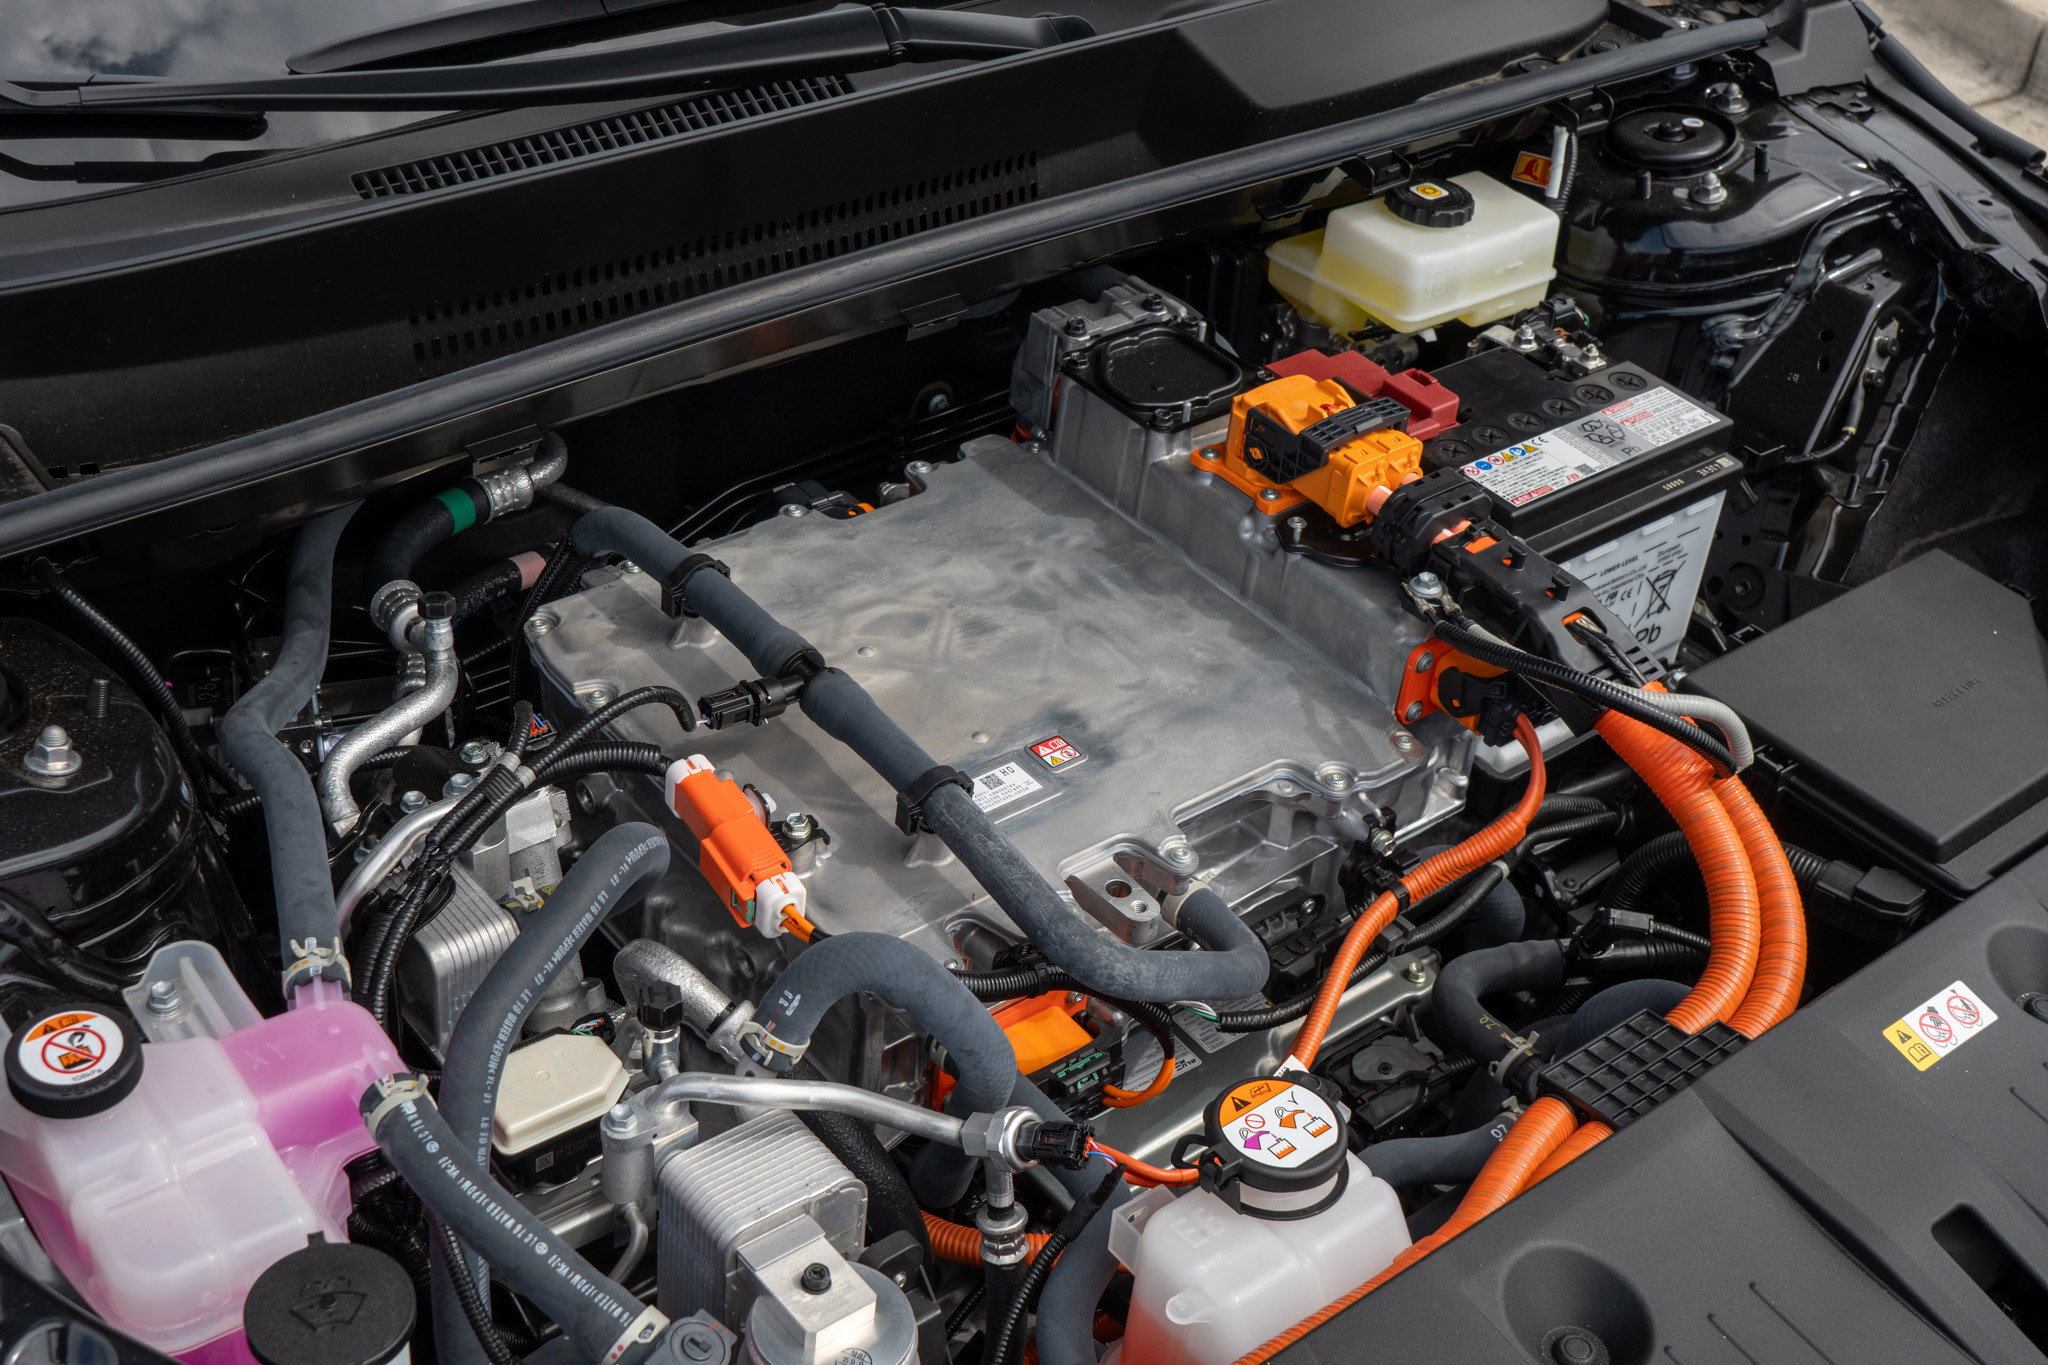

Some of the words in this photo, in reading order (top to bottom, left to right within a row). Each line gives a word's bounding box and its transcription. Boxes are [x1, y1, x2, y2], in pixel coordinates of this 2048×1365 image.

[1600, 563, 1621, 577] LOWER
[1621, 556, 1639, 568] LEVEL
[487, 1202, 516, 1229] WATER
